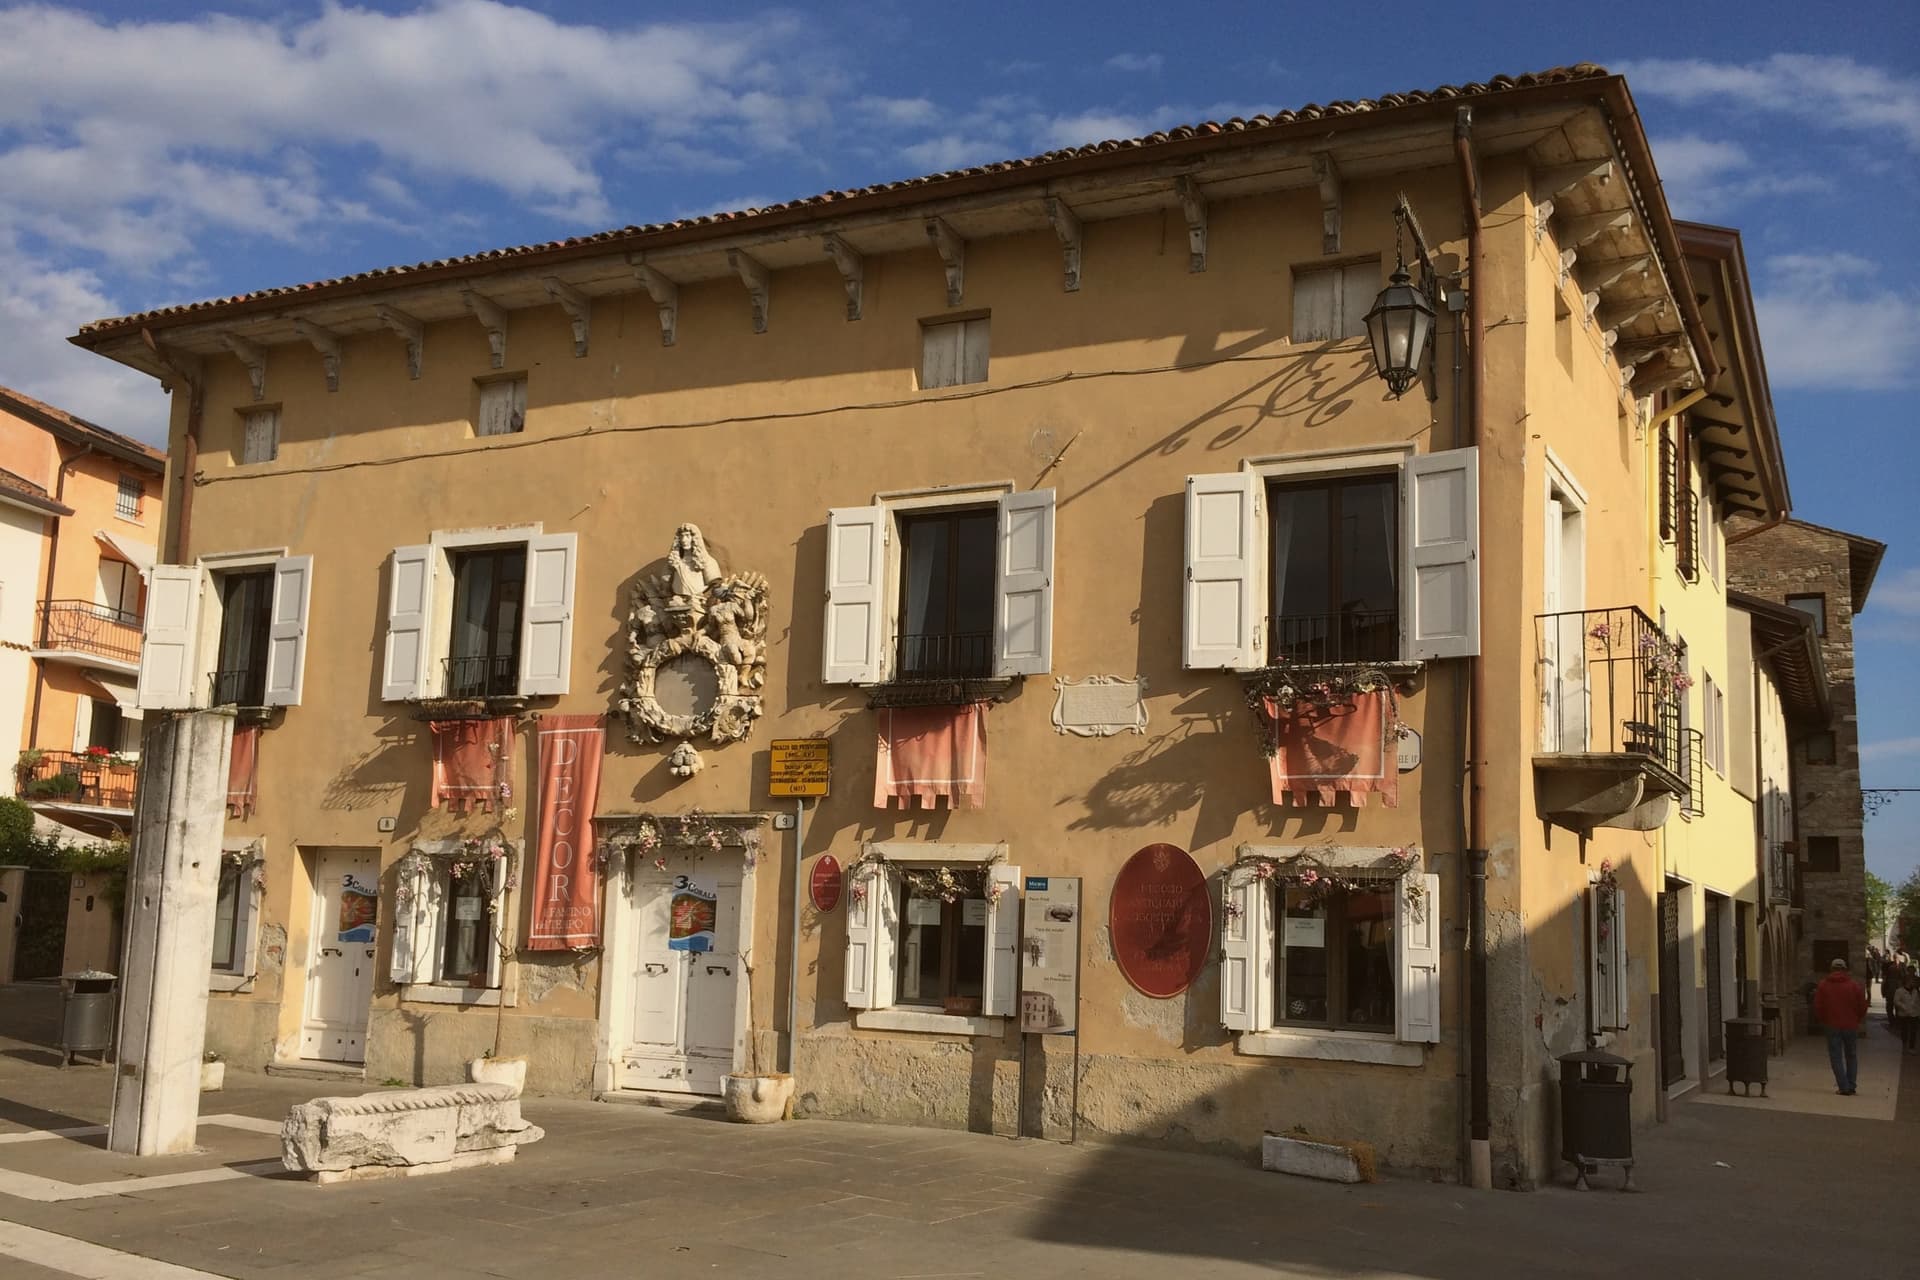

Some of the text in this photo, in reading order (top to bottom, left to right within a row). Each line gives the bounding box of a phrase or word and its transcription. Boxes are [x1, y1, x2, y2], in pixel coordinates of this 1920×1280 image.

[782, 817, 788, 826] 9
[343, 874, 354, 888] 3
[675, 875, 689, 889] 3
